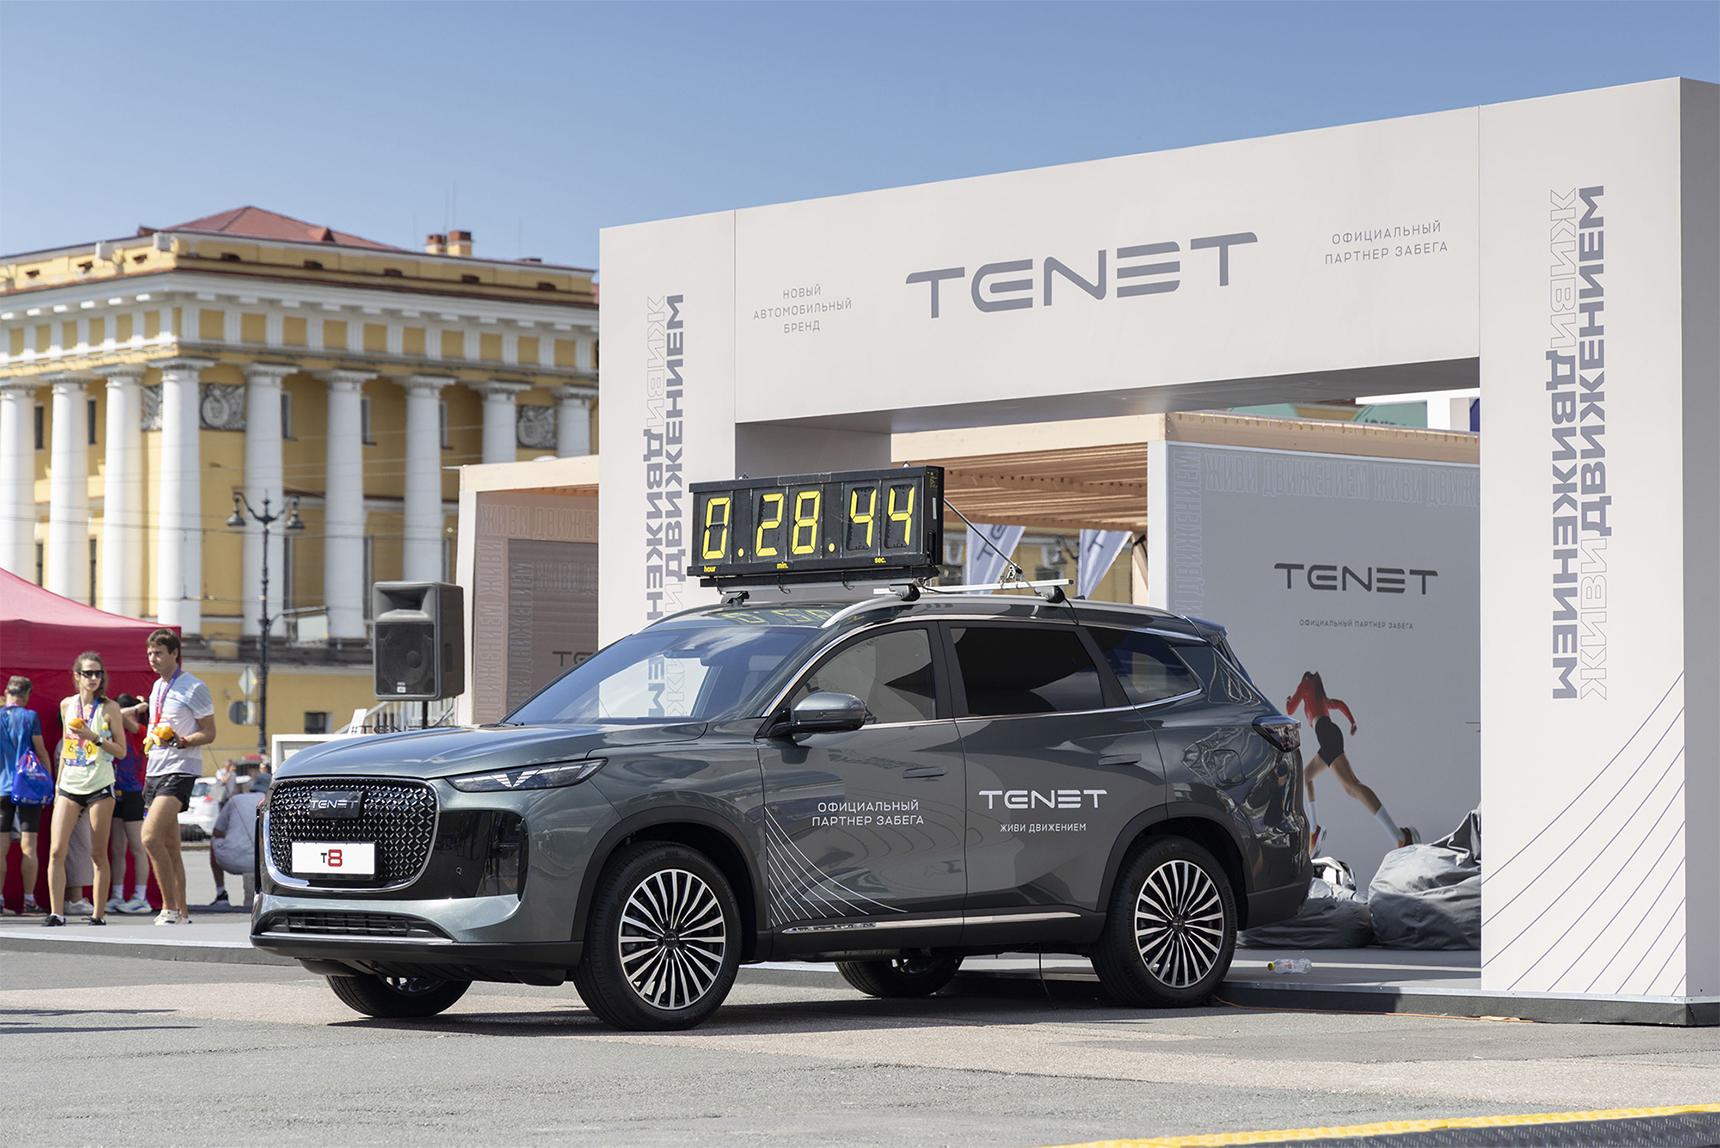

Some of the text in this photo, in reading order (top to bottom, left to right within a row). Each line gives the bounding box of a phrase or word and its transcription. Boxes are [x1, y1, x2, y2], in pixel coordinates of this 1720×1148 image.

[1331, 220, 1442, 245] ОФИЦИАЛЬНЫЙ
[1325, 241, 1449, 265] ПАРТНЕР ЗАБЕГА
[905, 231, 1259, 319] TENET
[783, 284, 822, 299] НОВЫЙ
[753, 299, 852, 320] АВТОМОБИЛЬНЫЙ
[783, 320, 821, 334] БРЕНД
[647, 295, 665, 428] ЖИВИ
[665, 294, 686, 582] ДВИЖЕНИЕМ
[1546, 187, 1578, 699] ЖИВИ ДВИЖЕНИЕМ
[1579, 185, 1612, 700] ЖИВИ ДВИЖЕНИЕМ
[703, 564, 717, 573] hour
[1274, 563, 1439, 595] TENET
[1299, 618, 1414, 630] ОФИЦИАЛЬНЫЙ ПАРТНЕР ЗАБЕГА
[817, 799, 920, 814] ОФИЦИАЛЬНЫЙ
[978, 789, 1108, 810] TENET
[811, 815, 924, 827] ПАРТНЕР ЗАБЕГА
[1000, 822, 1087, 834] ЖИВИ ДВИЖЕНИЕМ
[320, 849, 343, 867] T8
